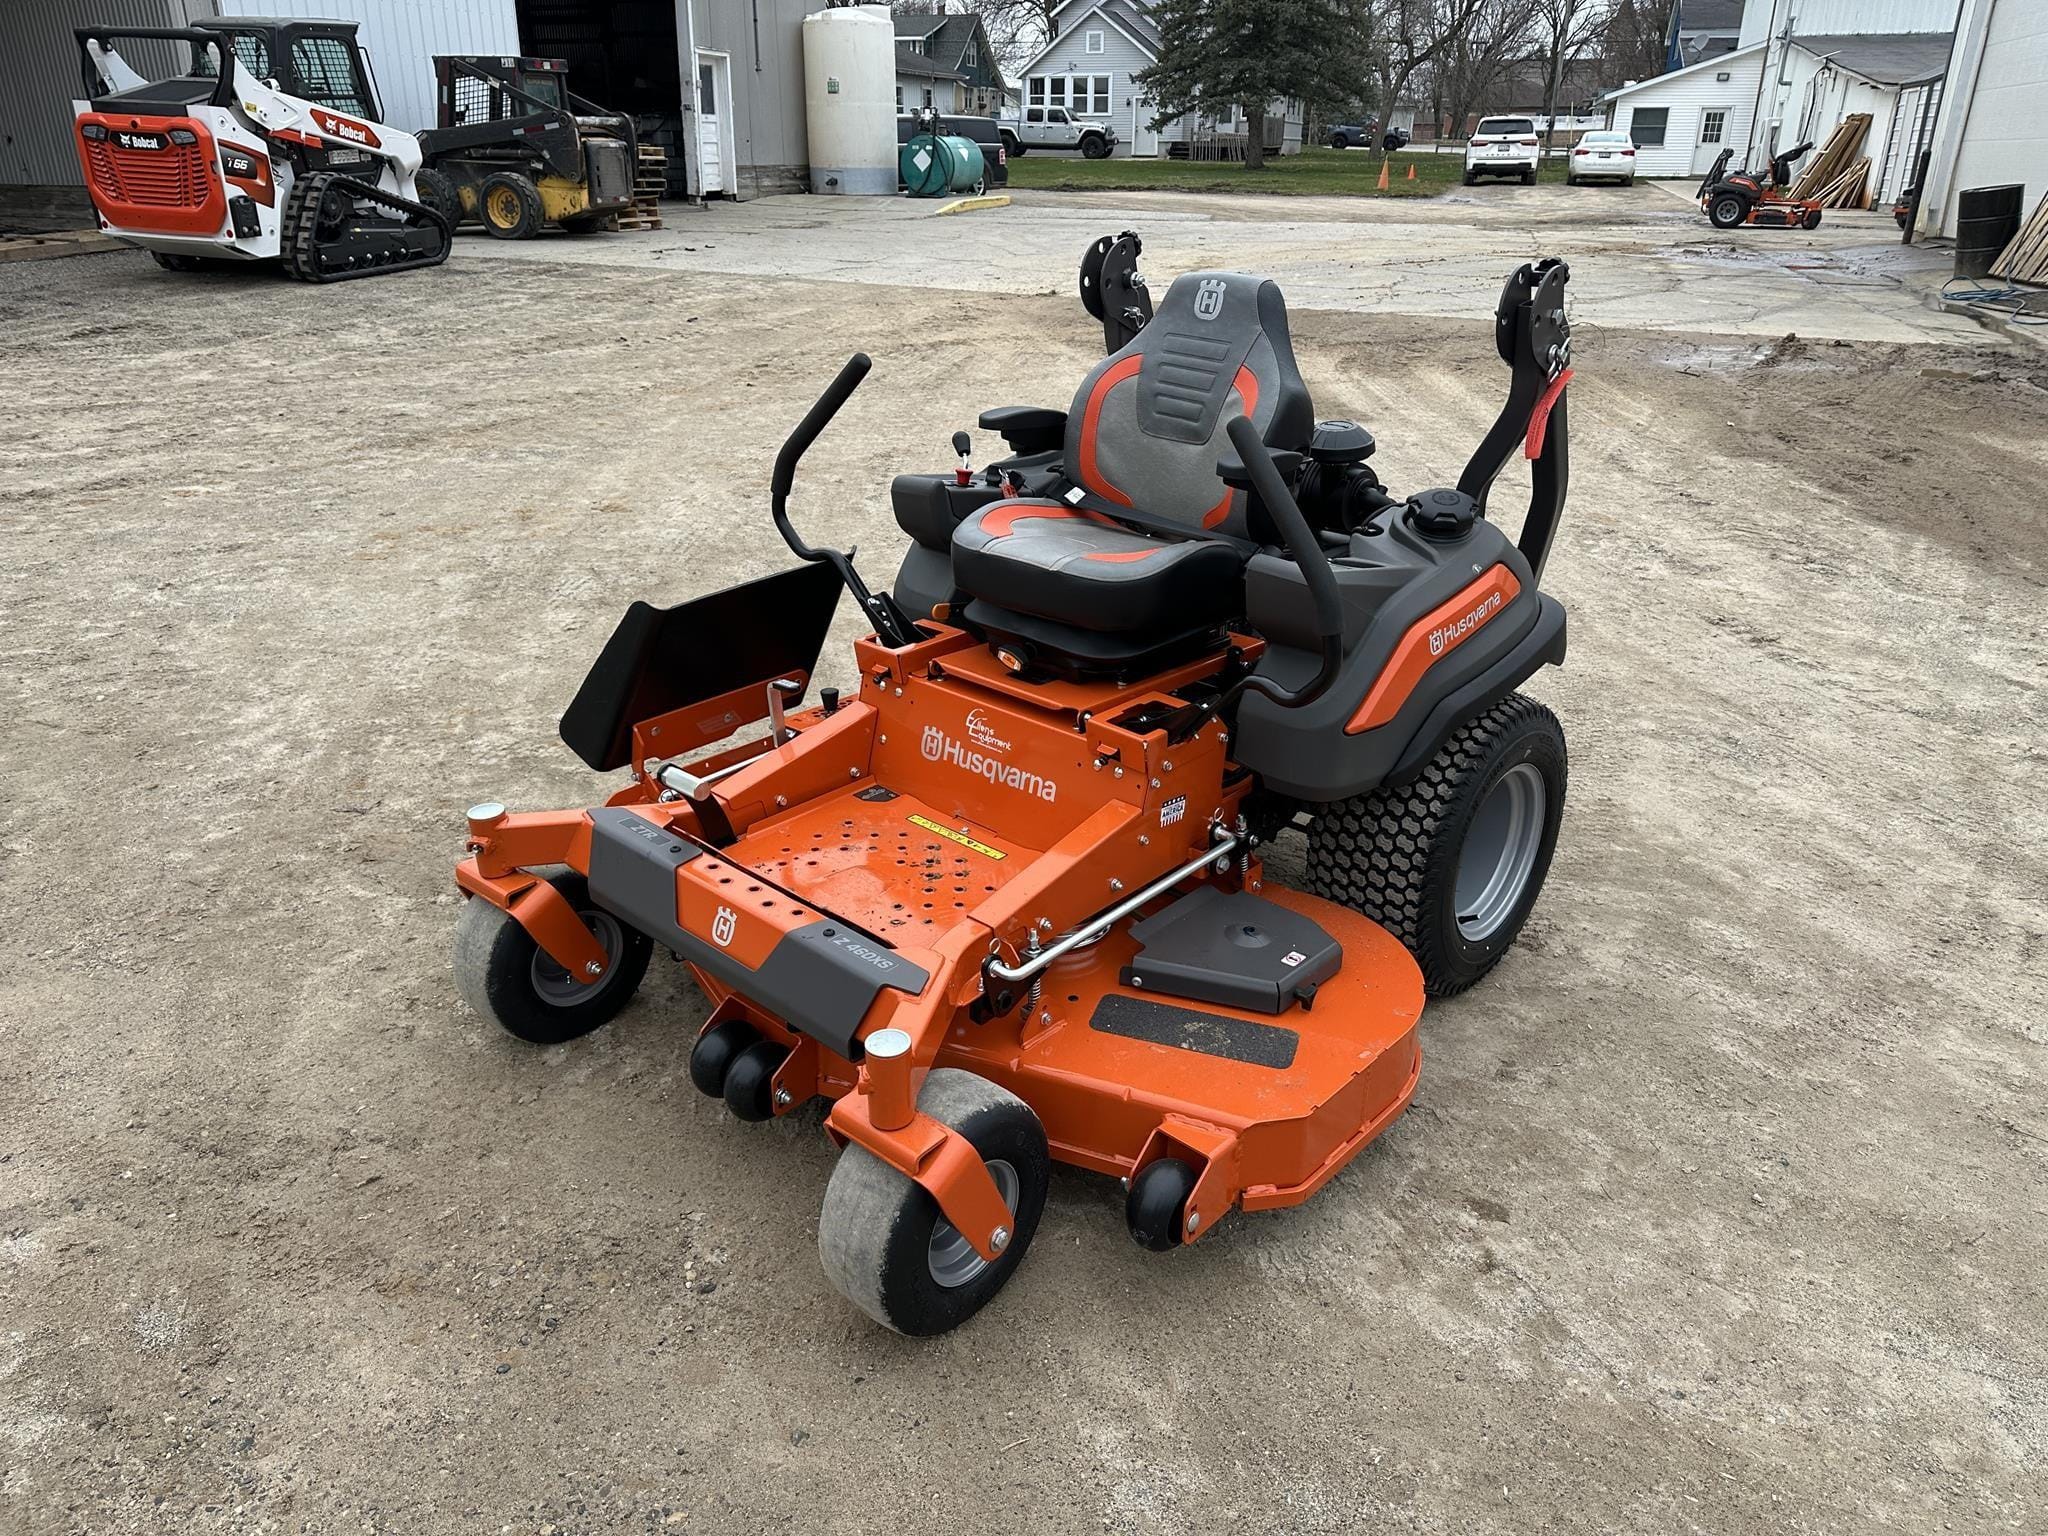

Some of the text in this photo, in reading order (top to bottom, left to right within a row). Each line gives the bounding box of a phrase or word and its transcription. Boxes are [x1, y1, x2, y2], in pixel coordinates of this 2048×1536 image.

[131, 135, 159, 149] Bobcat
[339, 123, 368, 143] Bobcat
[1443, 591, 1501, 645] Husqvarna
[943, 736, 1057, 803] Husqvarna
[833, 937, 894, 969] Z 460XS
